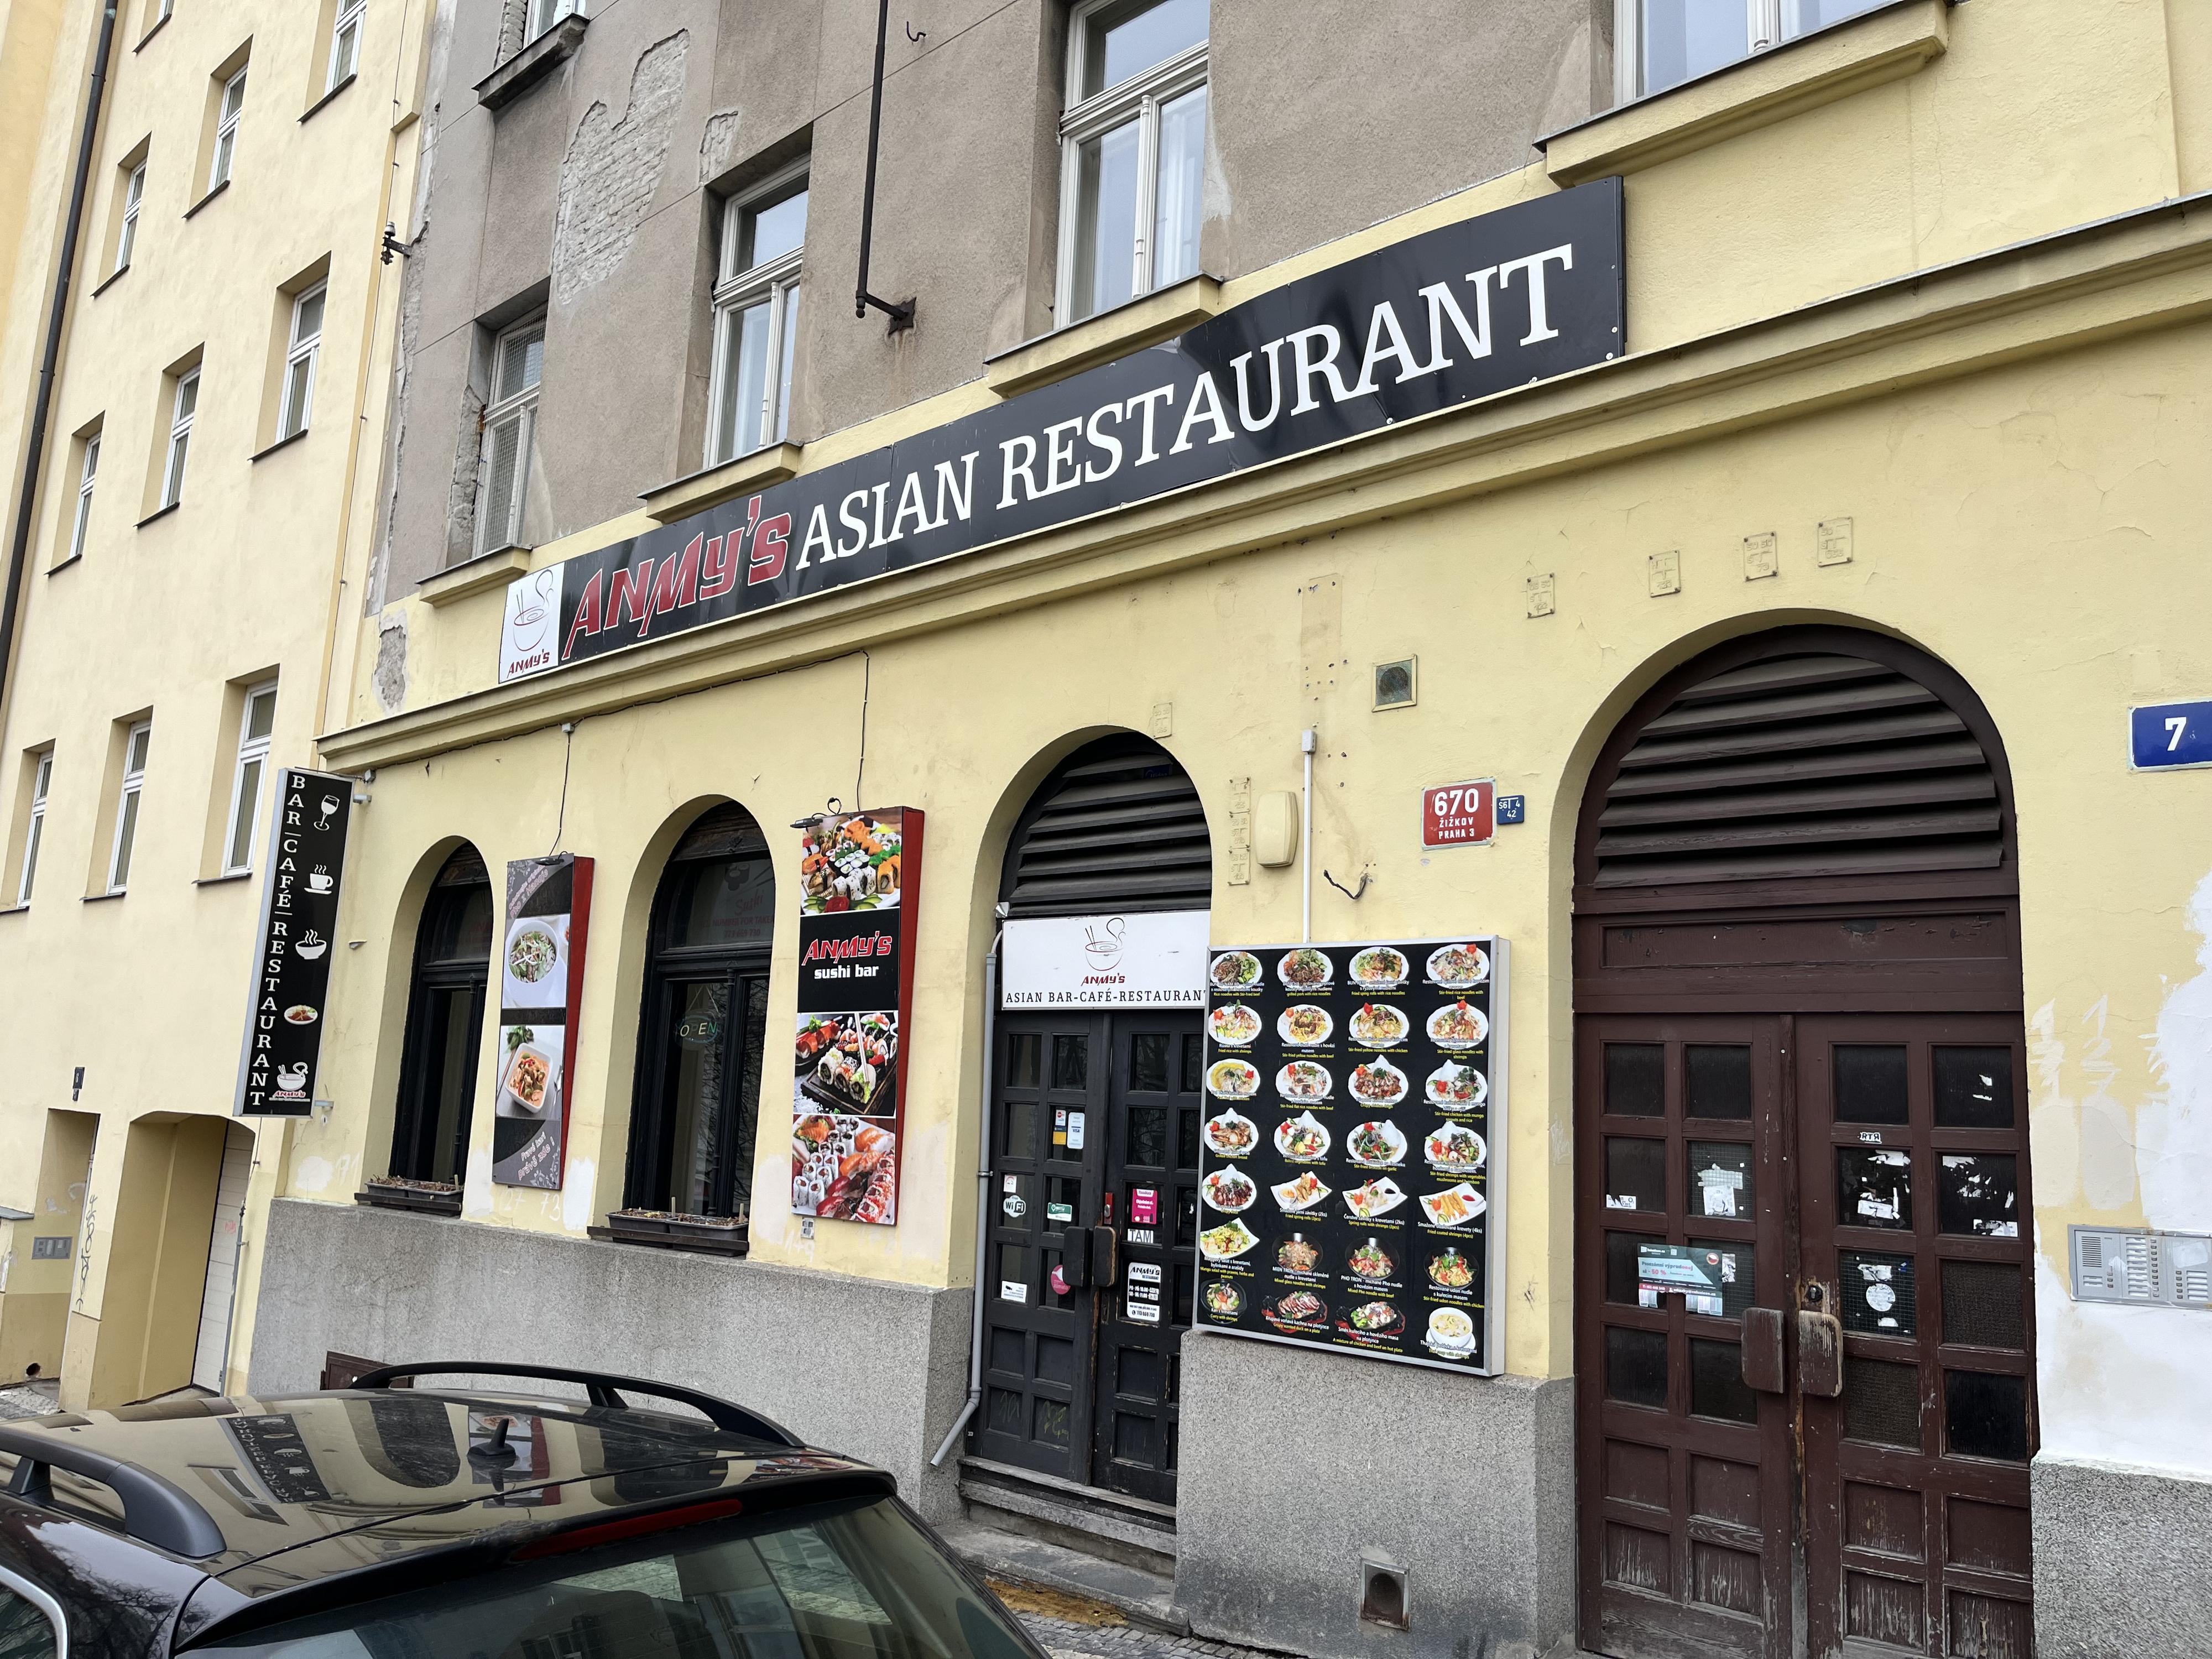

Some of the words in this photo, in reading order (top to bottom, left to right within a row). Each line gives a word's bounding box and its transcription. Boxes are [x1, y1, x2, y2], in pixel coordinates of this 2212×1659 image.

[796, 452, 978, 569] ASIAN
[997, 244, 1572, 509] RESTAURANT
[2165, 717, 2187, 752] 7
[1434, 788, 1479, 816] 670
[1439, 816, 1474, 828] ŽIŽKOV
[1438, 830, 1465, 840] PRAHA
[1469, 828, 1474, 837] 3
[814, 963, 851, 980] sushi
[854, 963, 879, 978] bar
[1006, 992, 1042, 1003] ASIAN
[1048, 988, 1206, 1002] BAR-CAFÉ-RESTAURAN
[680, 1022, 717, 1036] OPEN
[1130, 1229, 1151, 1243] TAM
